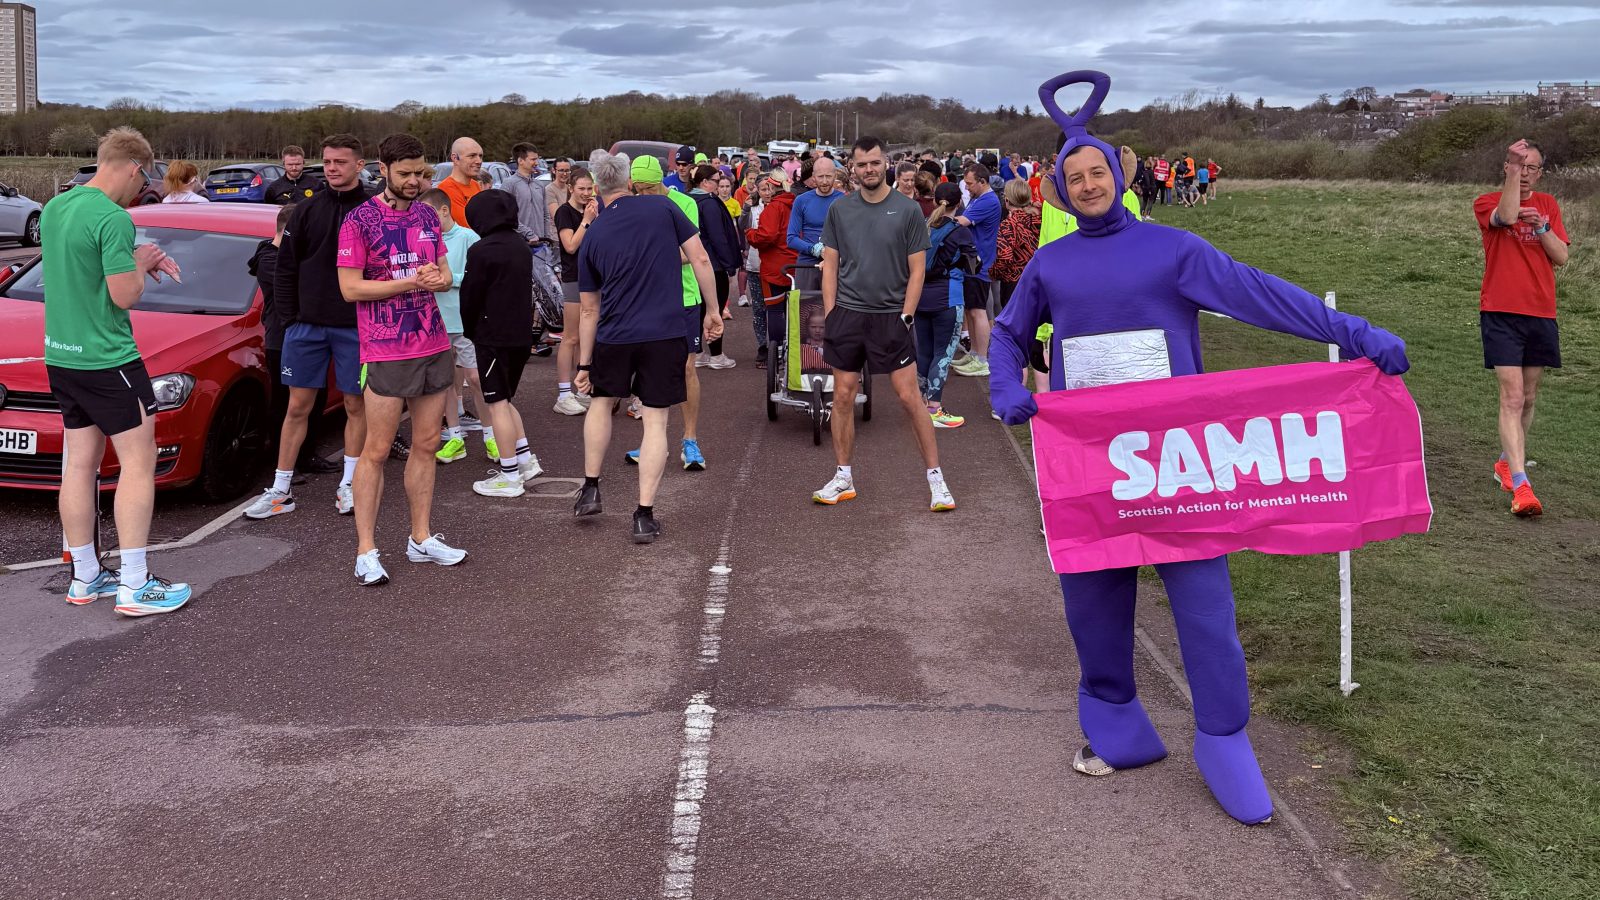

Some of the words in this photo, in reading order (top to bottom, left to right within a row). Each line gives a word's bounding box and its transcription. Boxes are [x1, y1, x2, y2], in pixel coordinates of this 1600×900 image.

[389, 253, 408, 265] WIZZ
[408, 252, 419, 263] AIR
[63, 343, 83, 353] Racing
[1108, 410, 1347, 501] SAMH
[1118, 506, 1173, 519] Scottish
[1176, 501, 1222, 514] Action
[1225, 501, 1244, 511] for
[1248, 494, 1297, 509] Mental
[1300, 491, 1348, 504] Health
[142, 592, 165, 600] HOKA
